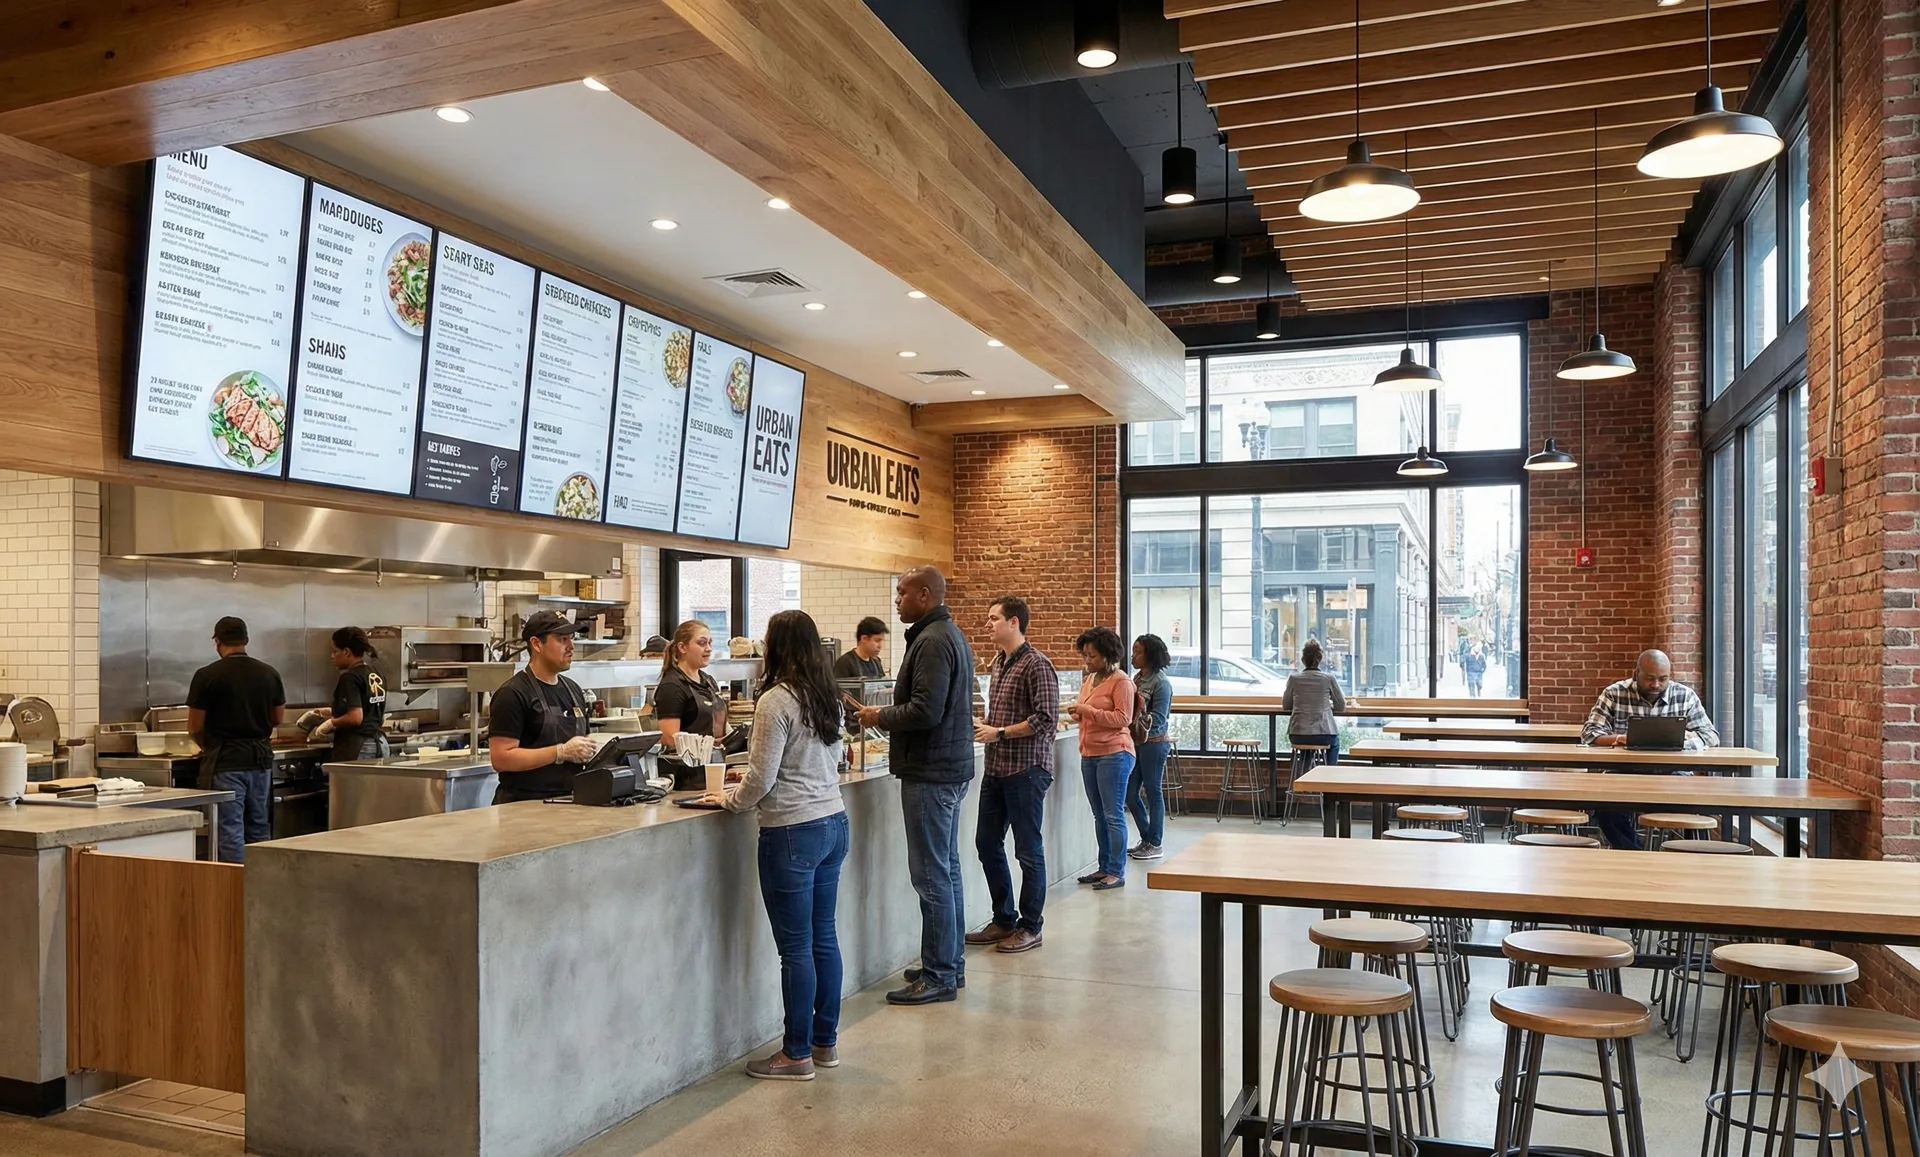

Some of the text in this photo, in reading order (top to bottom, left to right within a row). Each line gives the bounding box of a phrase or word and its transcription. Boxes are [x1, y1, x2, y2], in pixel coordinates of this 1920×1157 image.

[756, 405, 794, 440] URBAN
[753, 434, 791, 477] EATS
[826, 440, 882, 496] URBAN
[886, 458, 920, 505] EATS
